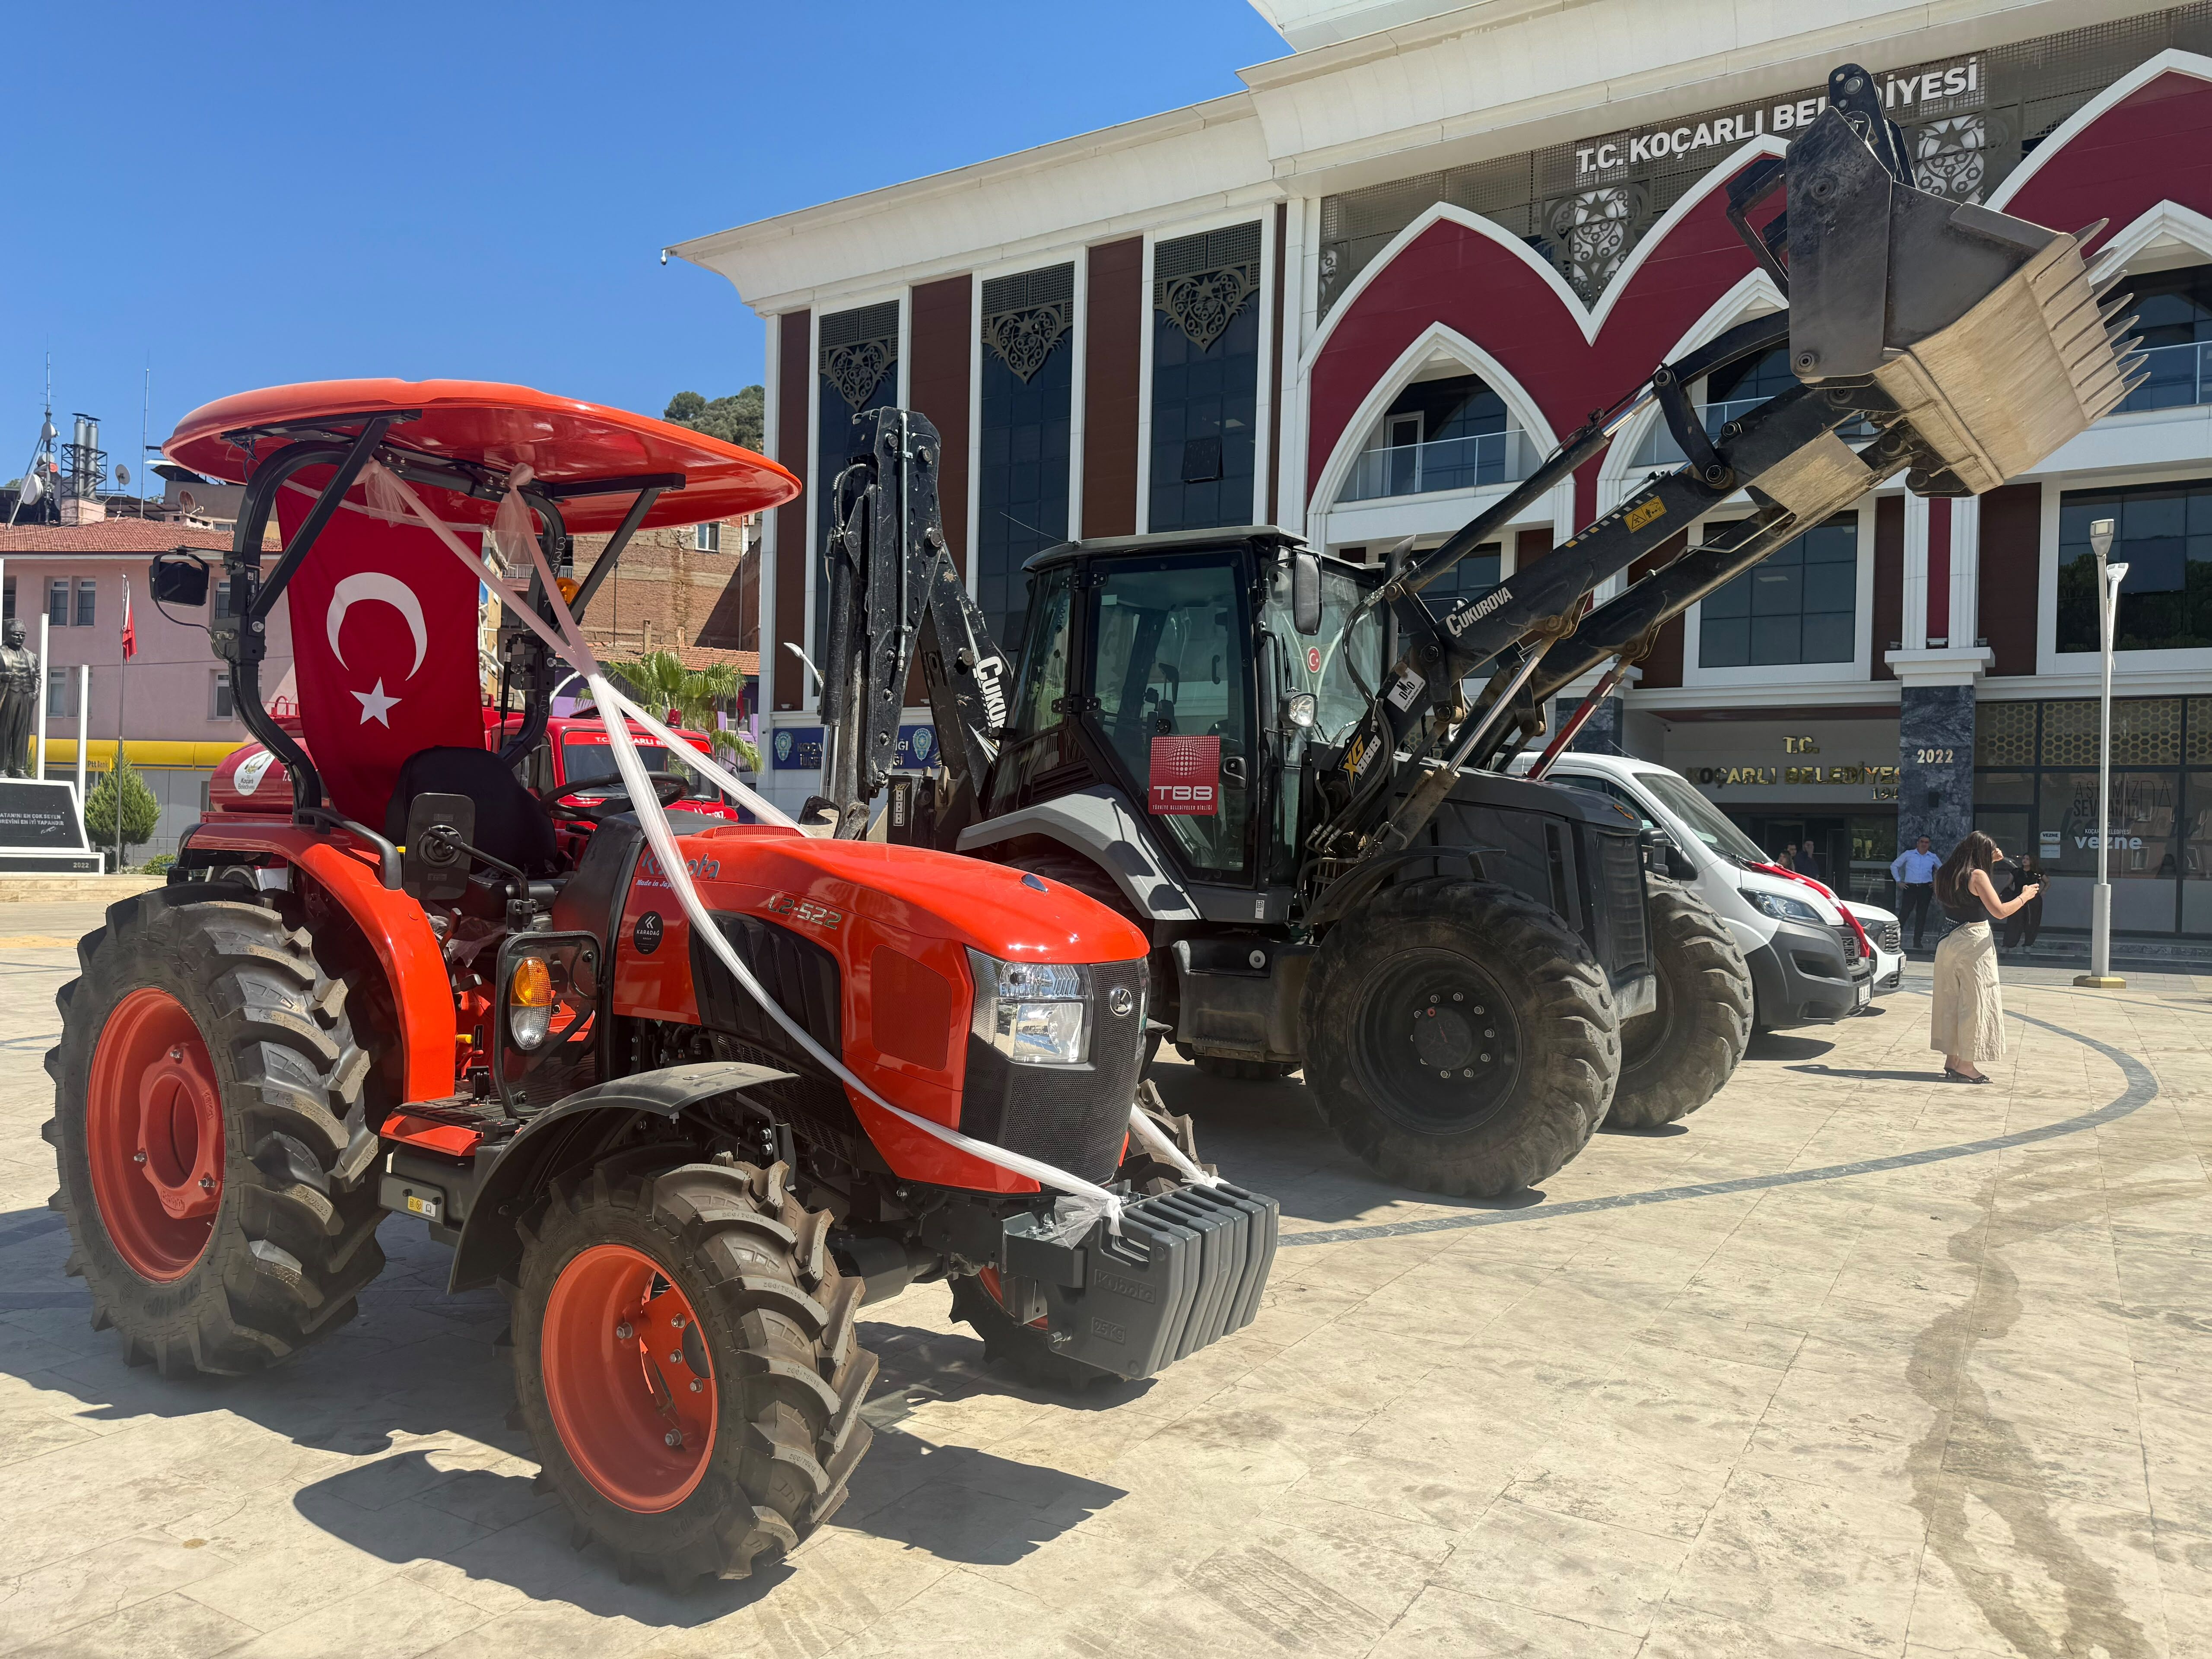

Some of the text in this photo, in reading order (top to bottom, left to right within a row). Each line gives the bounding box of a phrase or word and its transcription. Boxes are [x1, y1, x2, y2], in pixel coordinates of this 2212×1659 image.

[1575, 57, 1978, 174] T.C. KOÇARLI BELİYESİ
[1446, 587, 1513, 638] ÇUKUROVA
[1396, 681, 1415, 700] DMO
[1356, 734, 1381, 776] 888
[1783, 736, 1820, 754] T.C.
[1916, 749, 1954, 764] 2022
[1343, 734, 1364, 787] XG
[1686, 767, 1777, 789] KOÇARLI
[1154, 786, 1212, 800] TBB
[1098, 1271, 1154, 1300] Kubota
